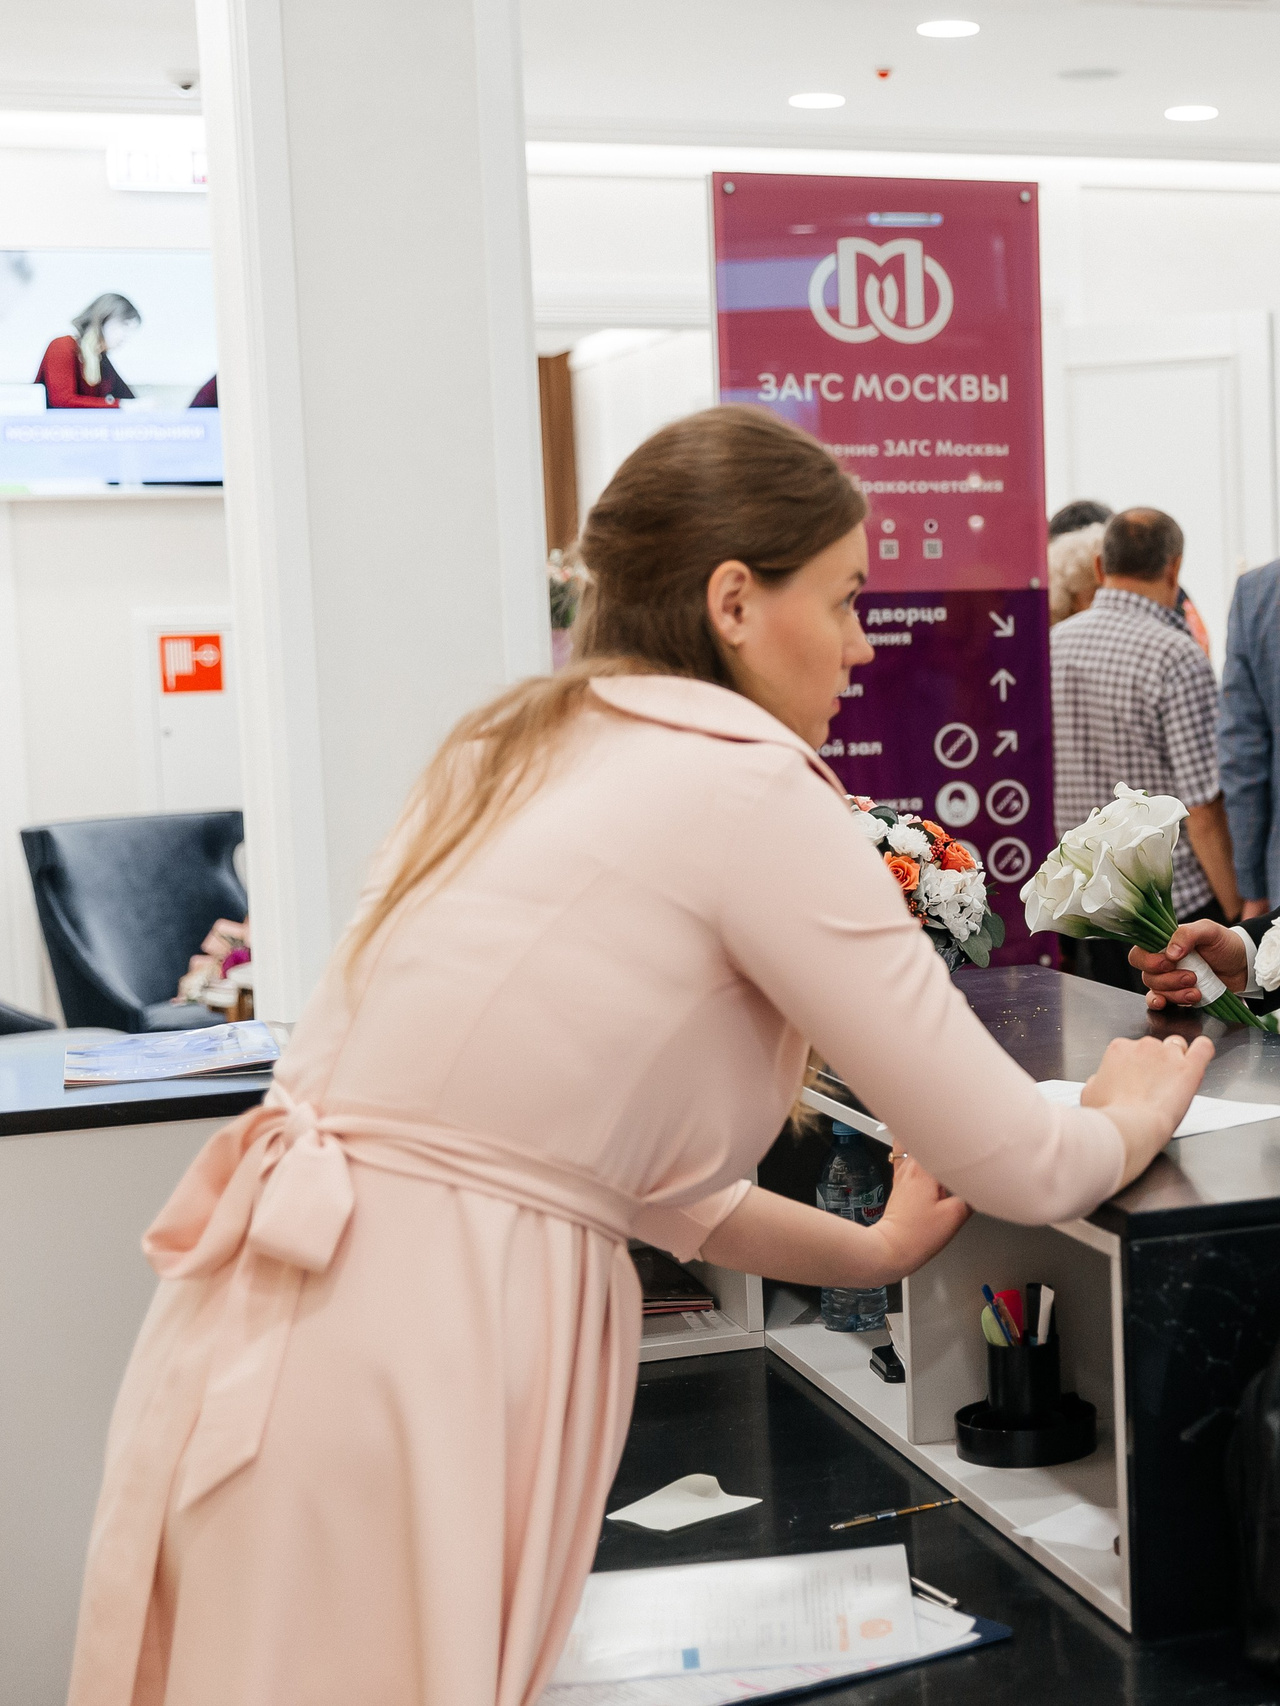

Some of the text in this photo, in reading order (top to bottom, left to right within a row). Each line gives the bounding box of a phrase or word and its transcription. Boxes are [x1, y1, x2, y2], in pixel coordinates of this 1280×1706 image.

[757, 373, 1009, 402] ЗАГС МОСКВЫ
[883, 439, 931, 457] ЗАГС
[935, 439, 1009, 457] Москвы
[866, 607, 948, 627] дворца
[817, 739, 882, 757] ой зал
